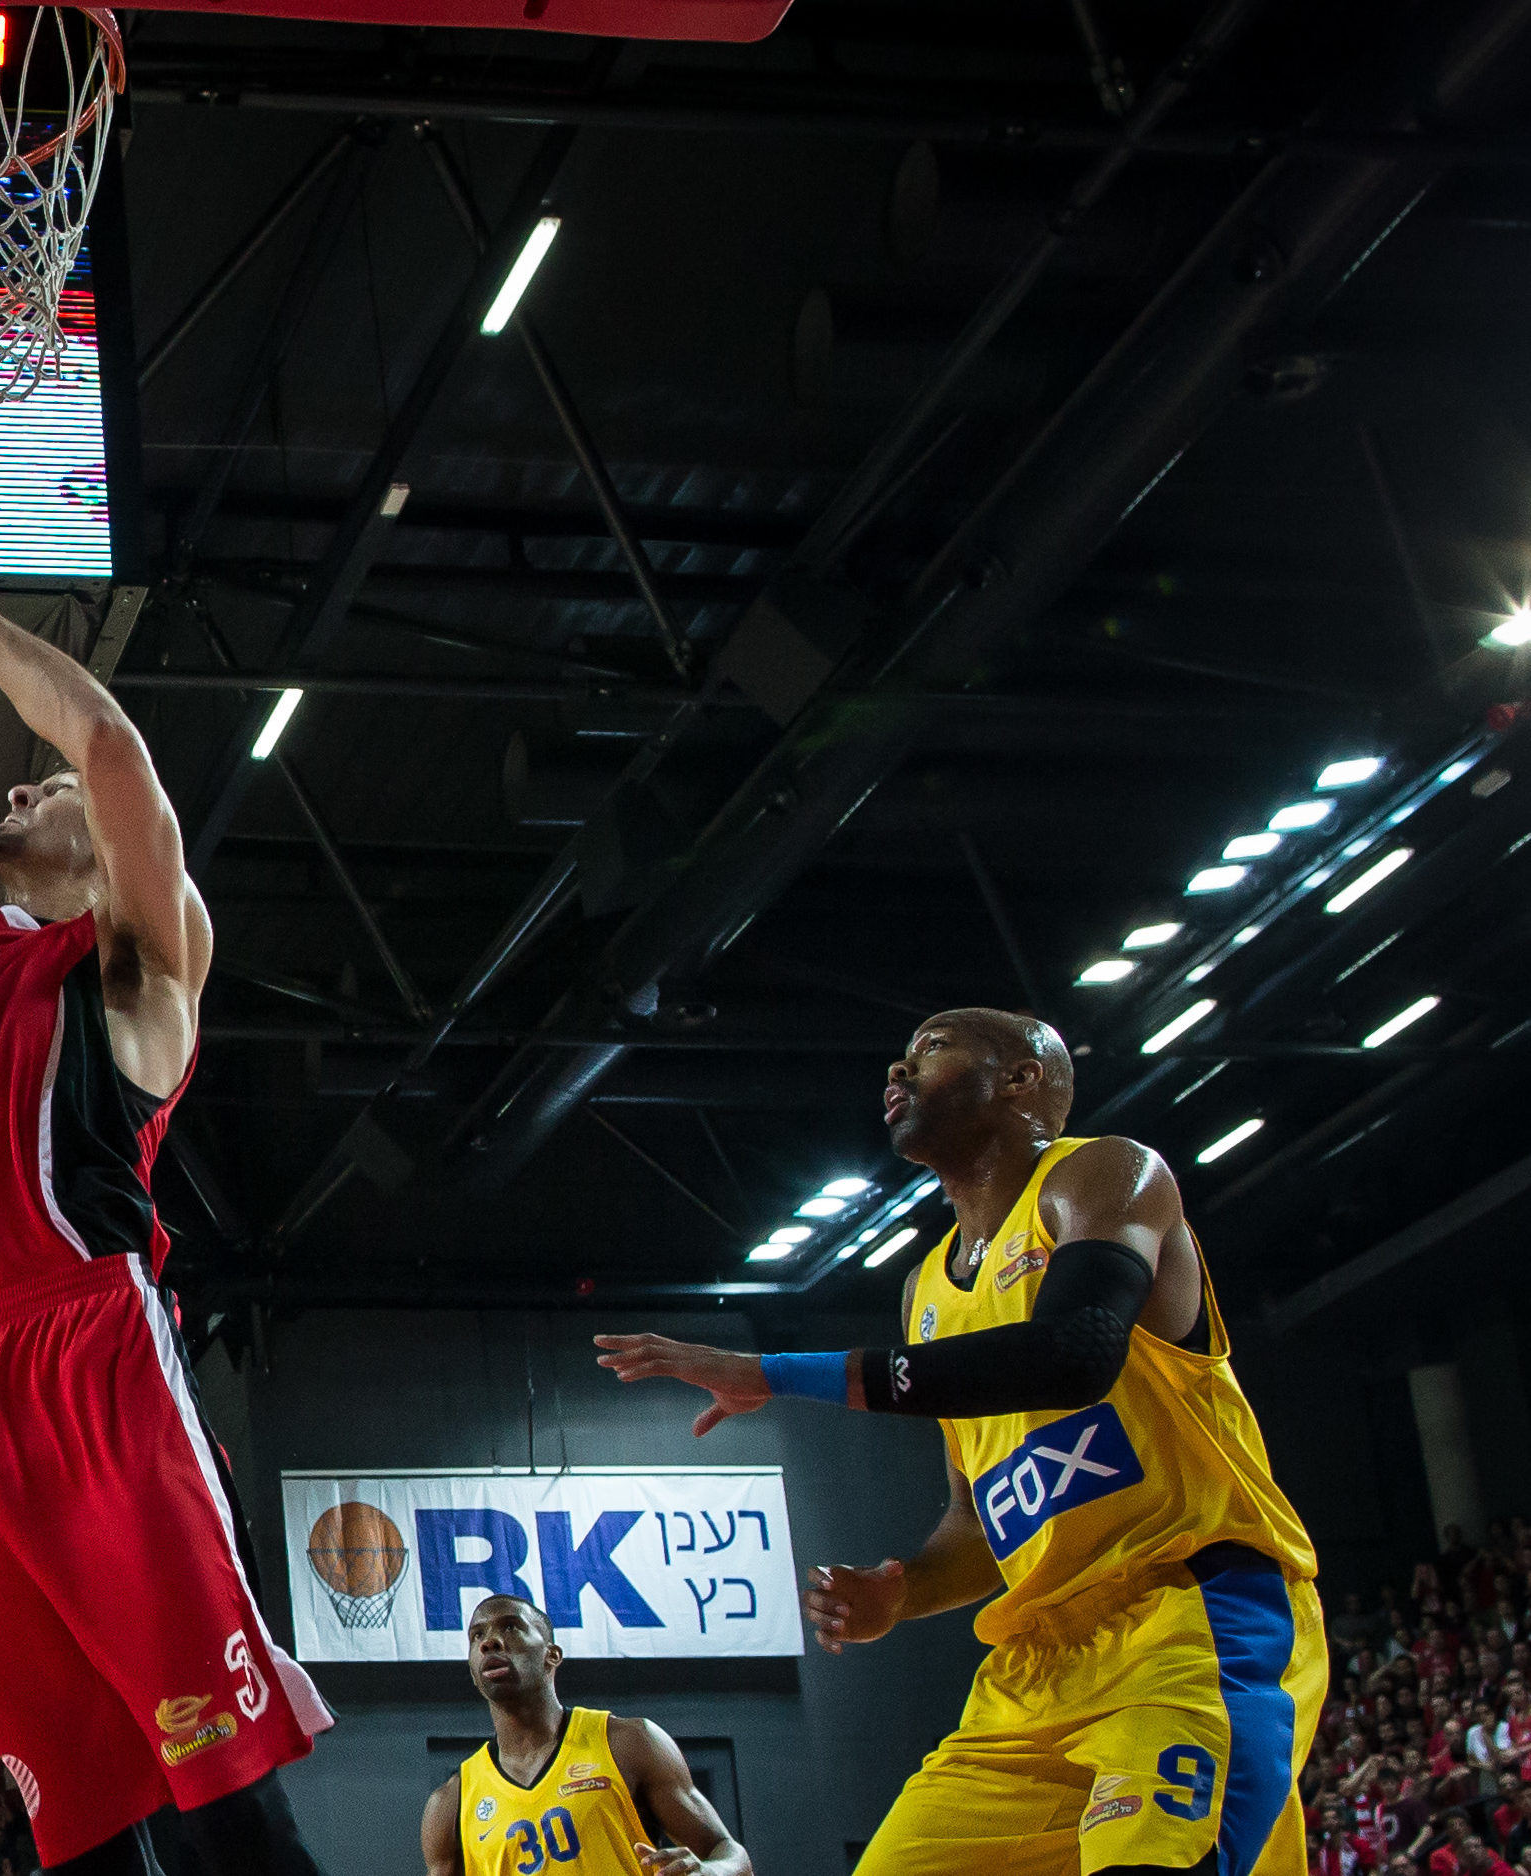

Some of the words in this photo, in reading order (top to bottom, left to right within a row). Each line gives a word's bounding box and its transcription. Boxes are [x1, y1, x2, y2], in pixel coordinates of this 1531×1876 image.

[986, 1423, 1121, 1542] FOX
[414, 1508, 667, 1632] RK
[654, 1509, 771, 1567] רענן
[684, 1577, 757, 1634] כץ
[1152, 1743, 1217, 1822] 9
[505, 1806, 582, 1875] 30
